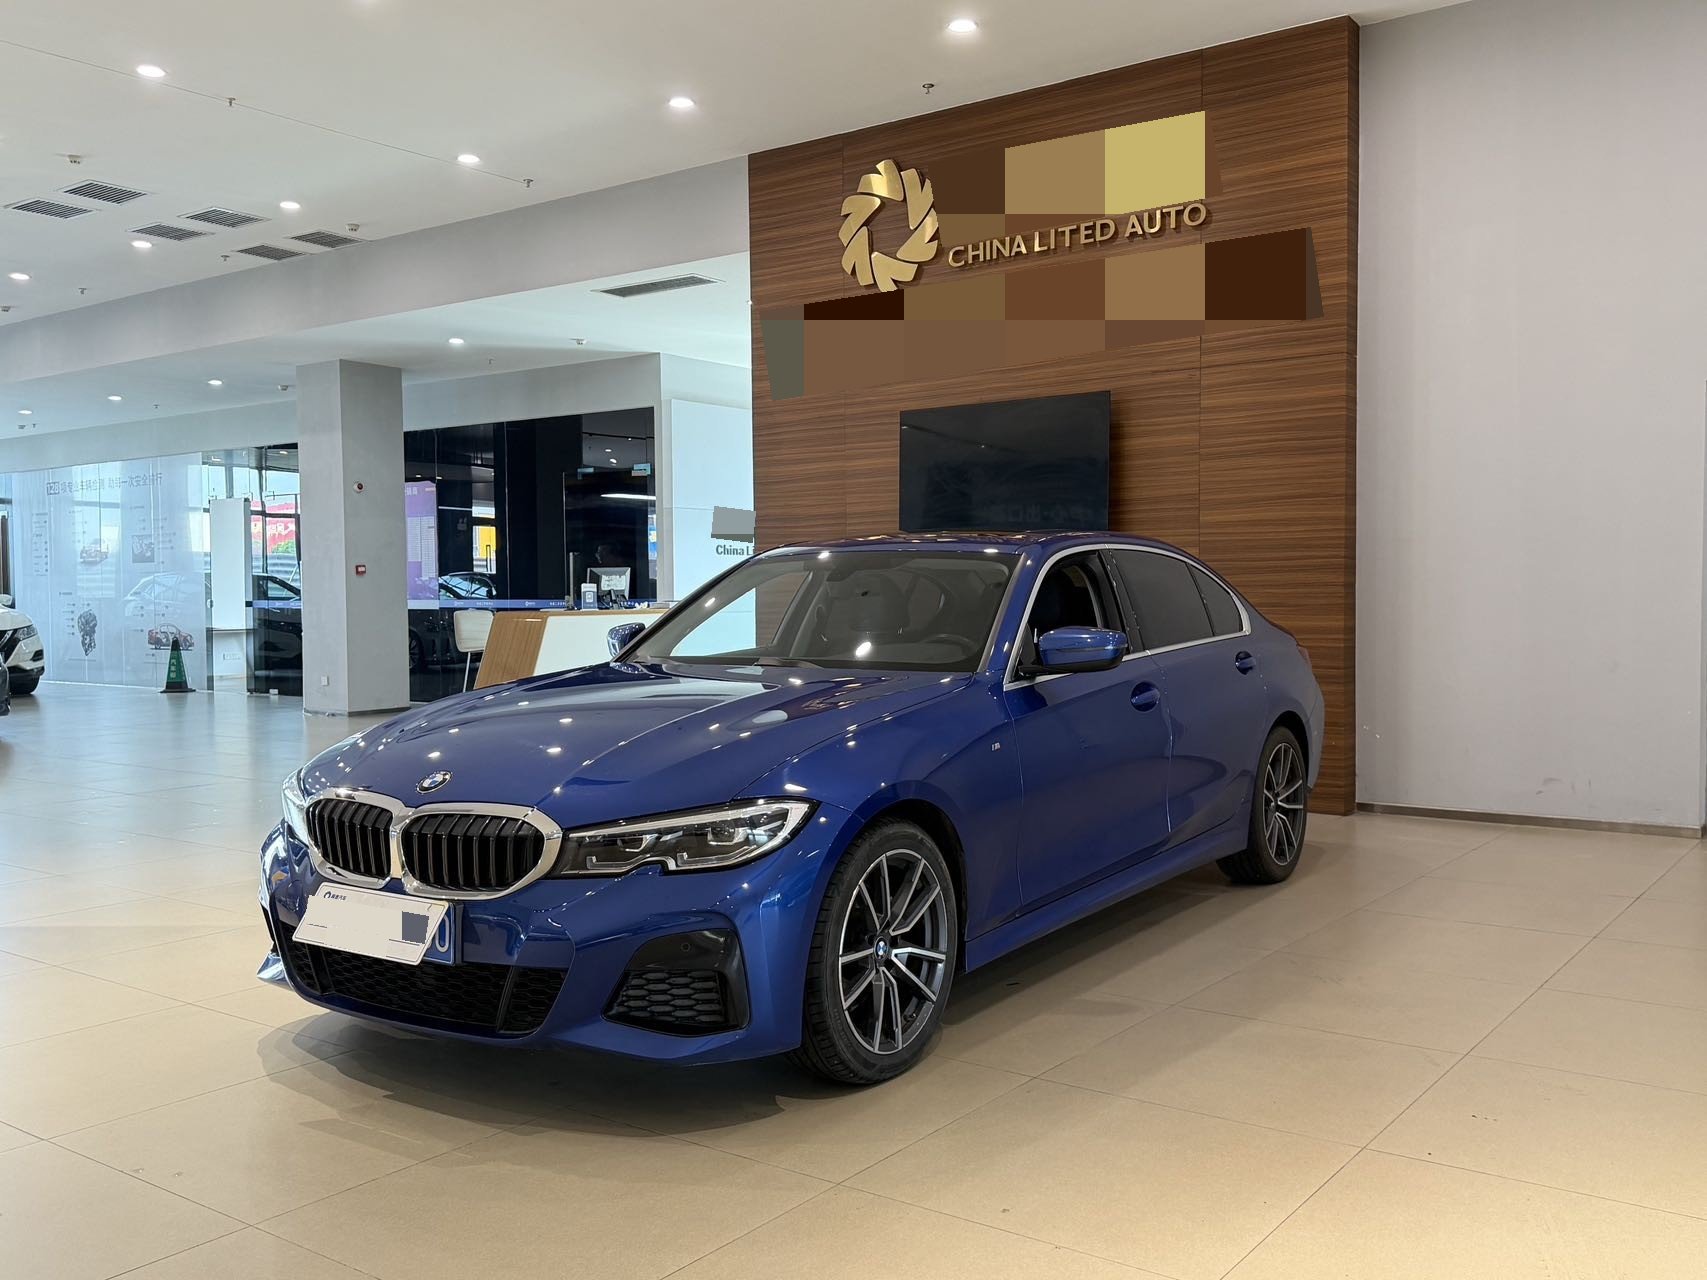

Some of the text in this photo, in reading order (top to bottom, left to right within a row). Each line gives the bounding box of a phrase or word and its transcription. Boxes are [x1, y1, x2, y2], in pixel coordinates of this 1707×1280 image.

[948, 202, 1208, 268] CHINA LITED AUTO
[715, 544, 745, 556] China
